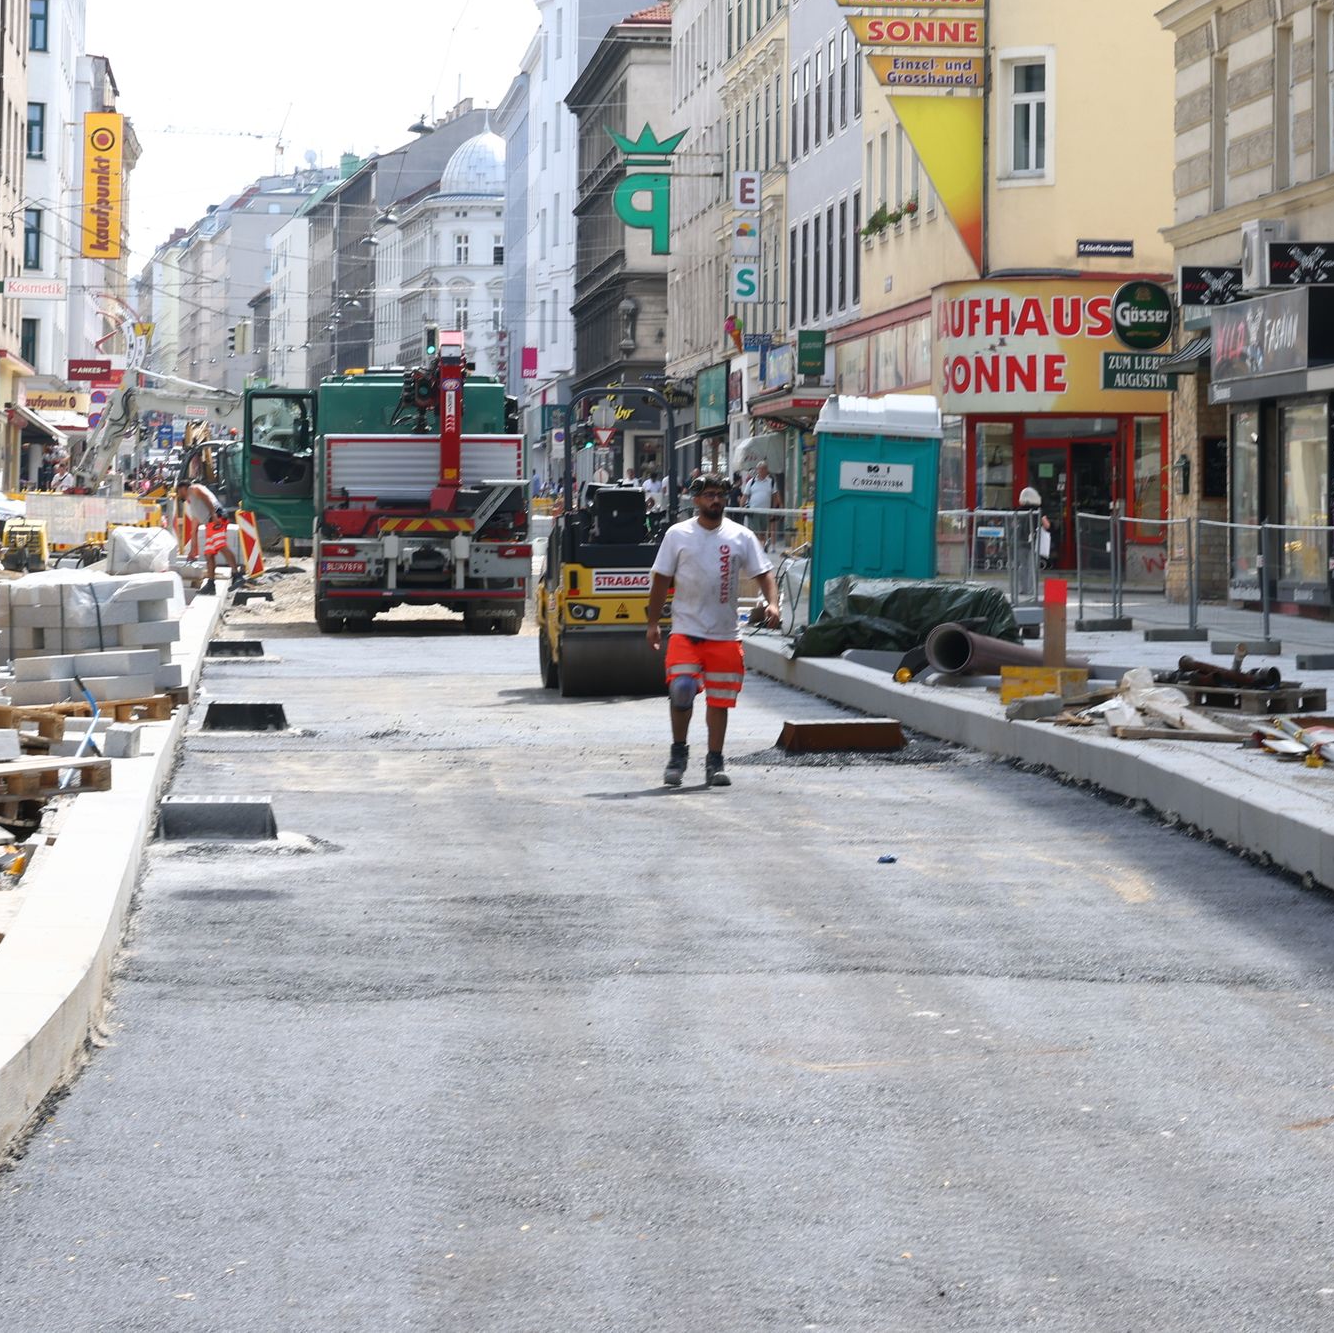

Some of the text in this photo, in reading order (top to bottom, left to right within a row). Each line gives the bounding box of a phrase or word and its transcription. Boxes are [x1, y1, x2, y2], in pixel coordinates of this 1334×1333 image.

[867, 20, 979, 43] SONNE
[893, 58, 972, 71] Einzel- und
[886, 71, 978, 84] Grosshandel
[89, 155, 113, 252] kaufpunkt
[8, 281, 64, 295] Kosmetik
[1116, 301, 1170, 327] Gösser
[1107, 355, 1132, 371] ZUM
[942, 353, 1069, 396] SONNE
[1114, 373, 1167, 389] AUGUSTIN
[595, 576, 650, 587] STRABAG
[720, 544, 731, 605] STRABAG
